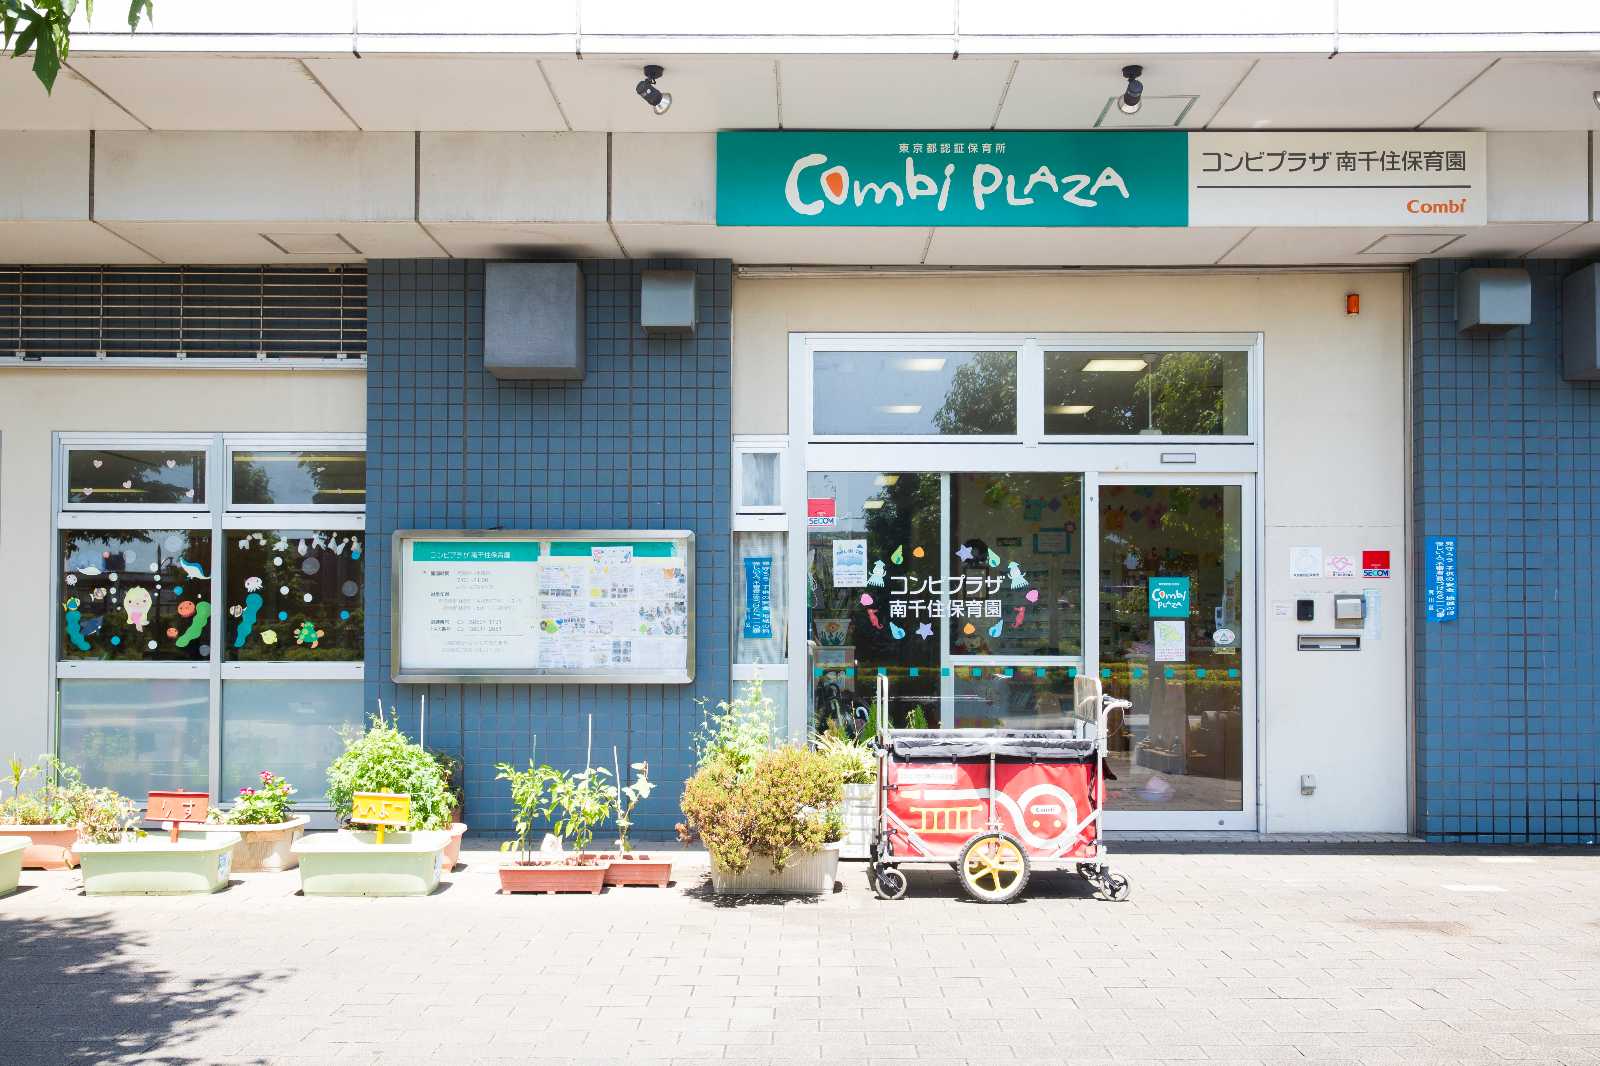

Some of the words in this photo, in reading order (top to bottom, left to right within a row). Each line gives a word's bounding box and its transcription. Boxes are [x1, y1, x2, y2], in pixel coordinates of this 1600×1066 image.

[899, 143, 1006, 154] 東京都認証保育所
[785, 153, 956, 216] Combi
[972, 163, 1130, 211] PLAZA
[1406, 198, 1467, 214] Combi
[808, 517, 835, 525] SECOM
[1363, 569, 1389, 577] SECOM
[890, 574, 1005, 595] コンビプラザ
[1151, 588, 1187, 602] Combi
[889, 599, 1002, 618] 南千住保育園
